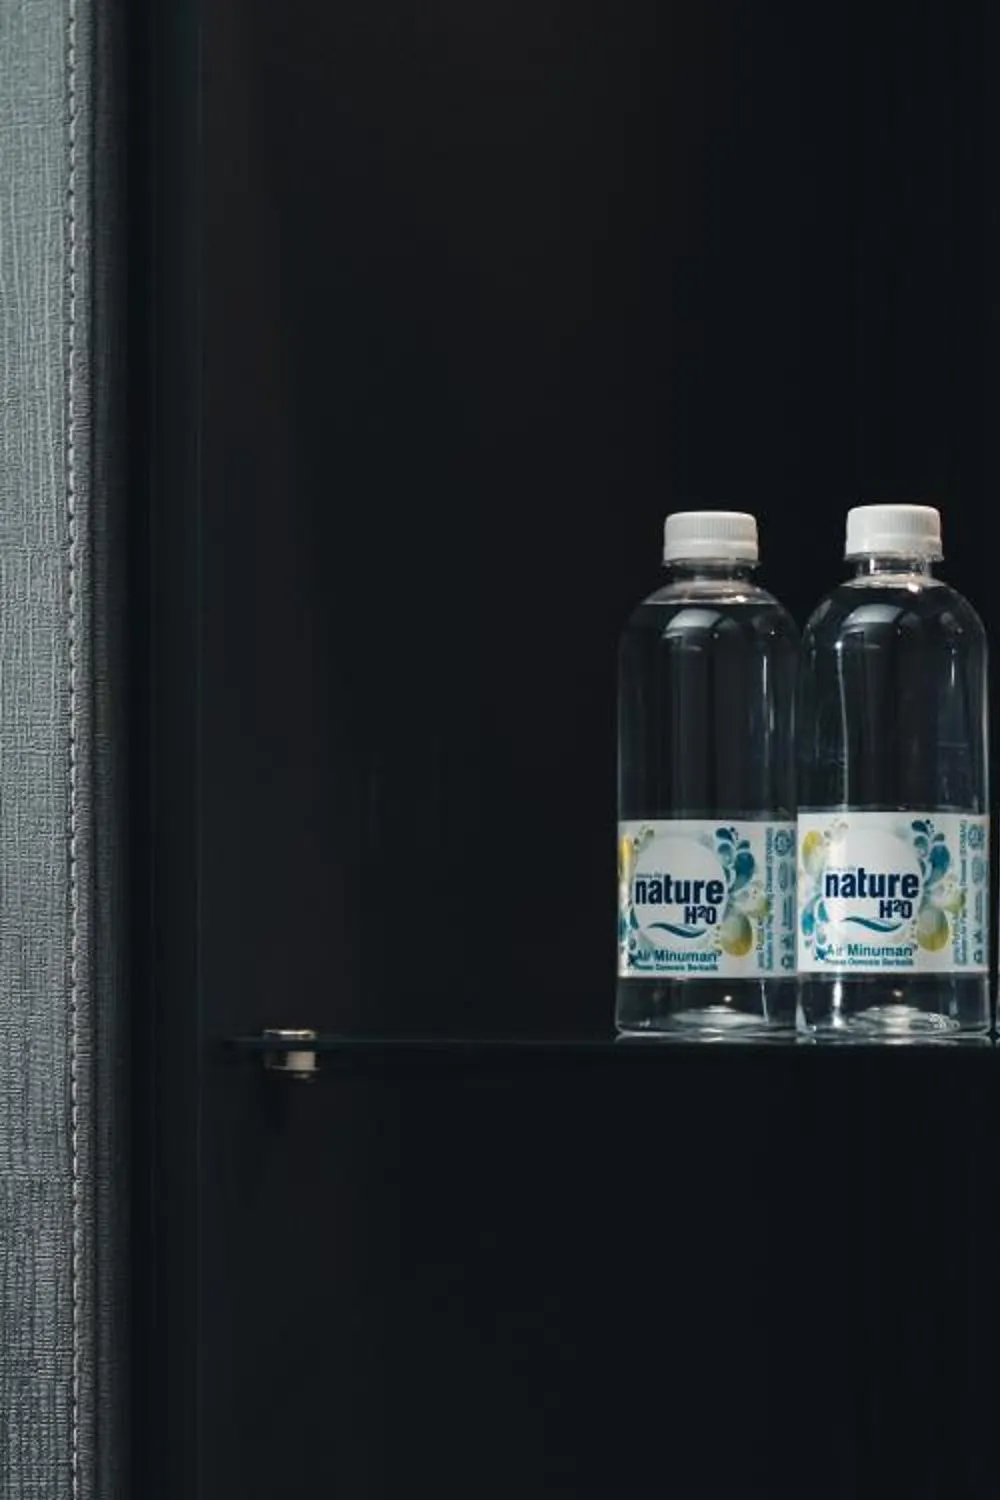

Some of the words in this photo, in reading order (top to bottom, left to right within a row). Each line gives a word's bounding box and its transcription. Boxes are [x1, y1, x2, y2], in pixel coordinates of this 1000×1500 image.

[635, 874, 724, 905] nature
[825, 868, 919, 898] nature
[654, 950, 717, 961] Minuman
[847, 943, 913, 956] Minuman
